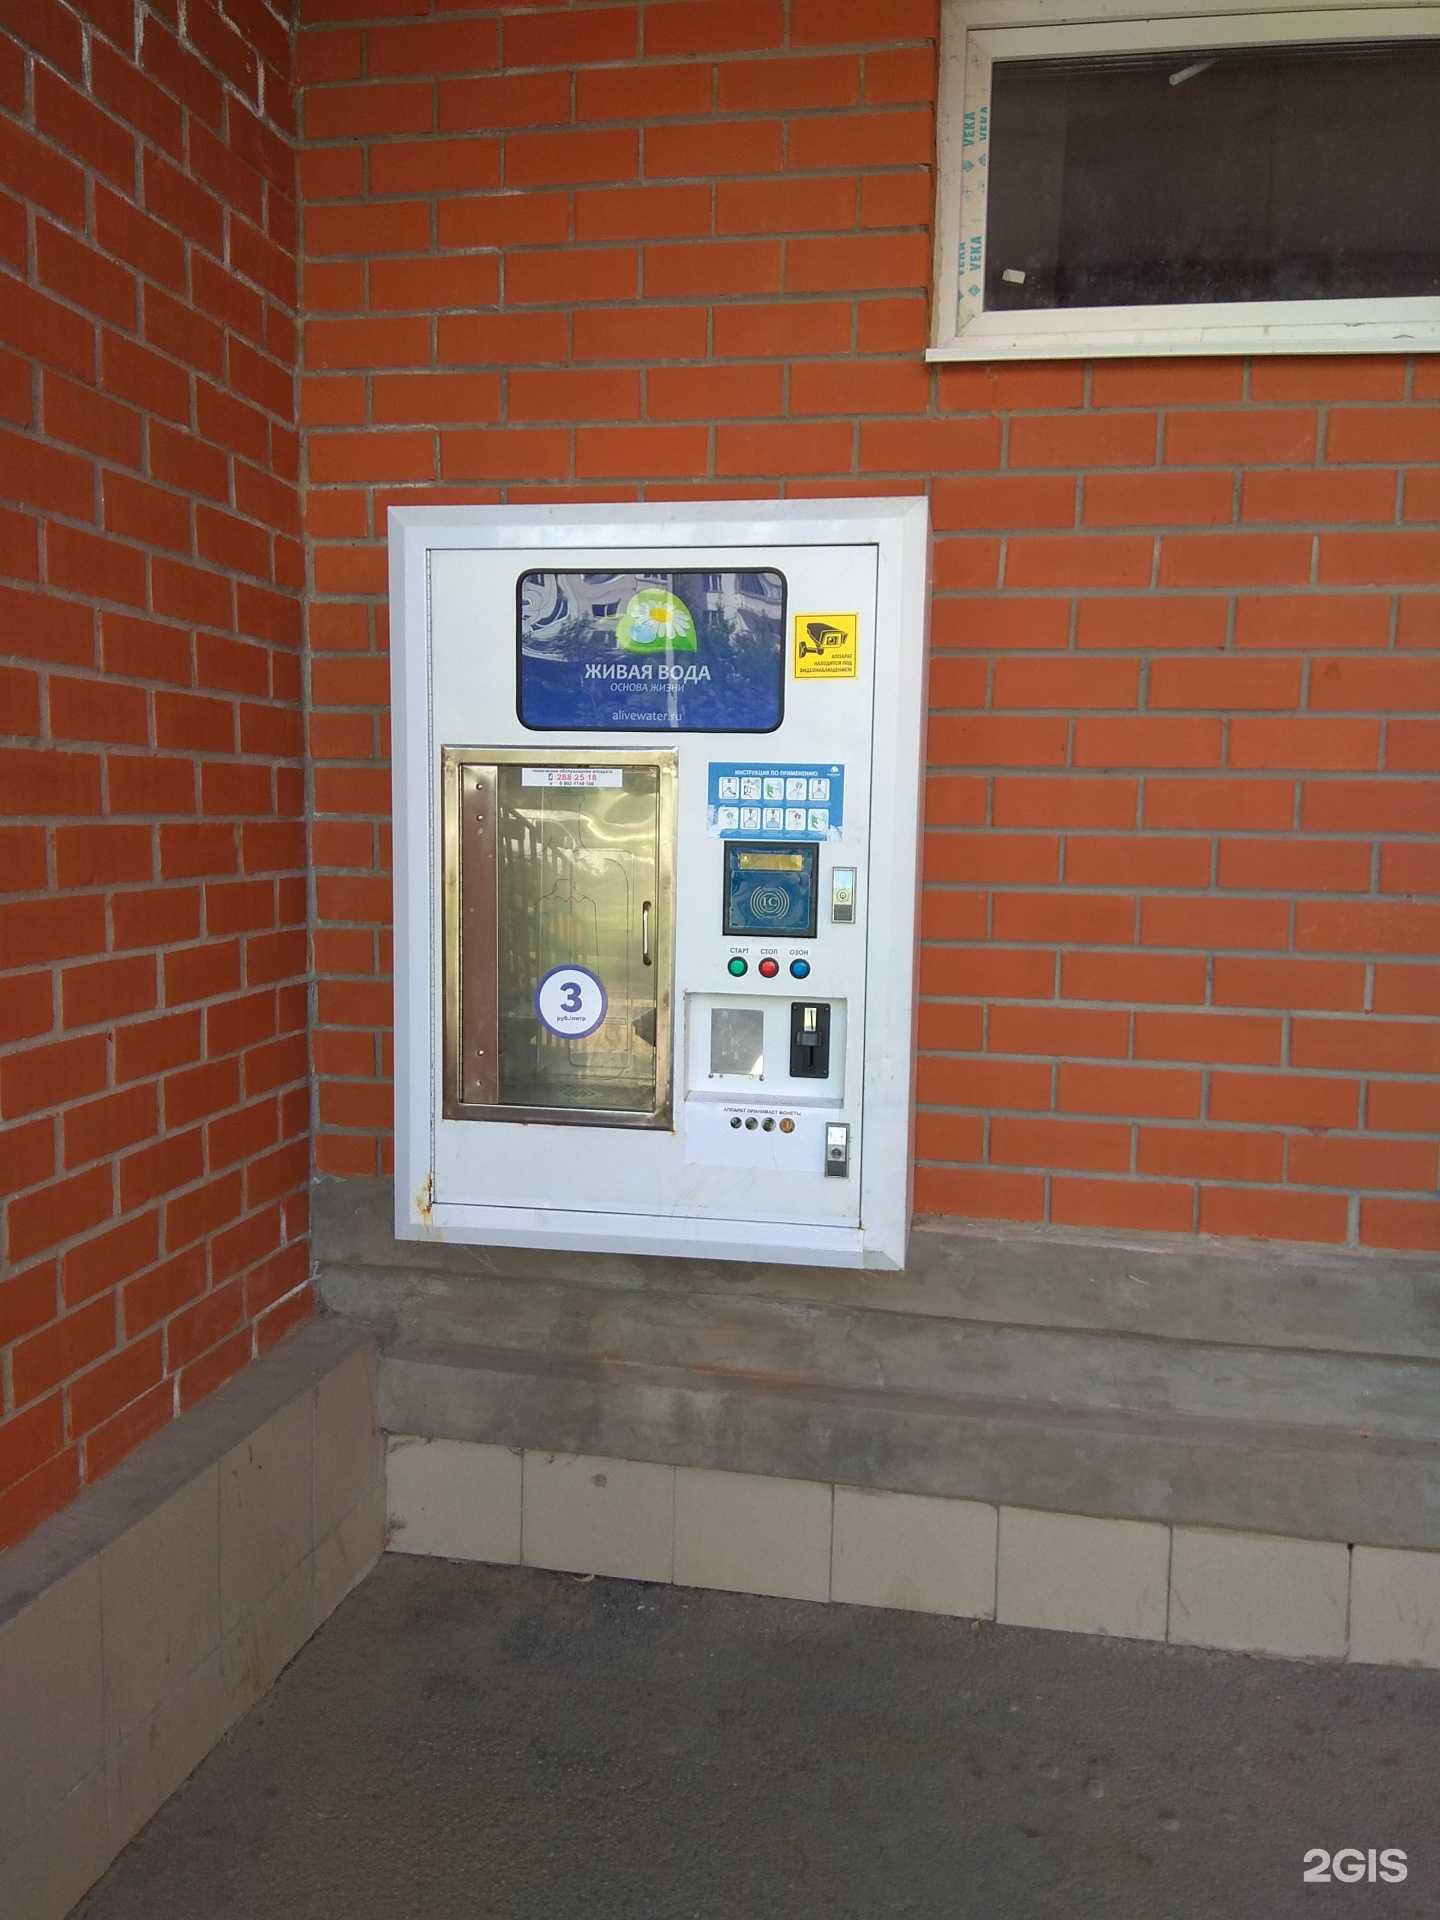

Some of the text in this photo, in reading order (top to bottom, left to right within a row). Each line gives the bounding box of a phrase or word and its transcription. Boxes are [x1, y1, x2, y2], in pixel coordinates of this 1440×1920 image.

[963, 111, 976, 147] VEKA
[970, 235, 982, 271] VEKA
[585, 664, 711, 684] ЖИВАЯ ВОДА
[610, 682, 685, 693] ОСНОВА ЖИЗНИ
[612, 709, 682, 721] alivewater.ru
[560, 982, 583, 1013] 3
